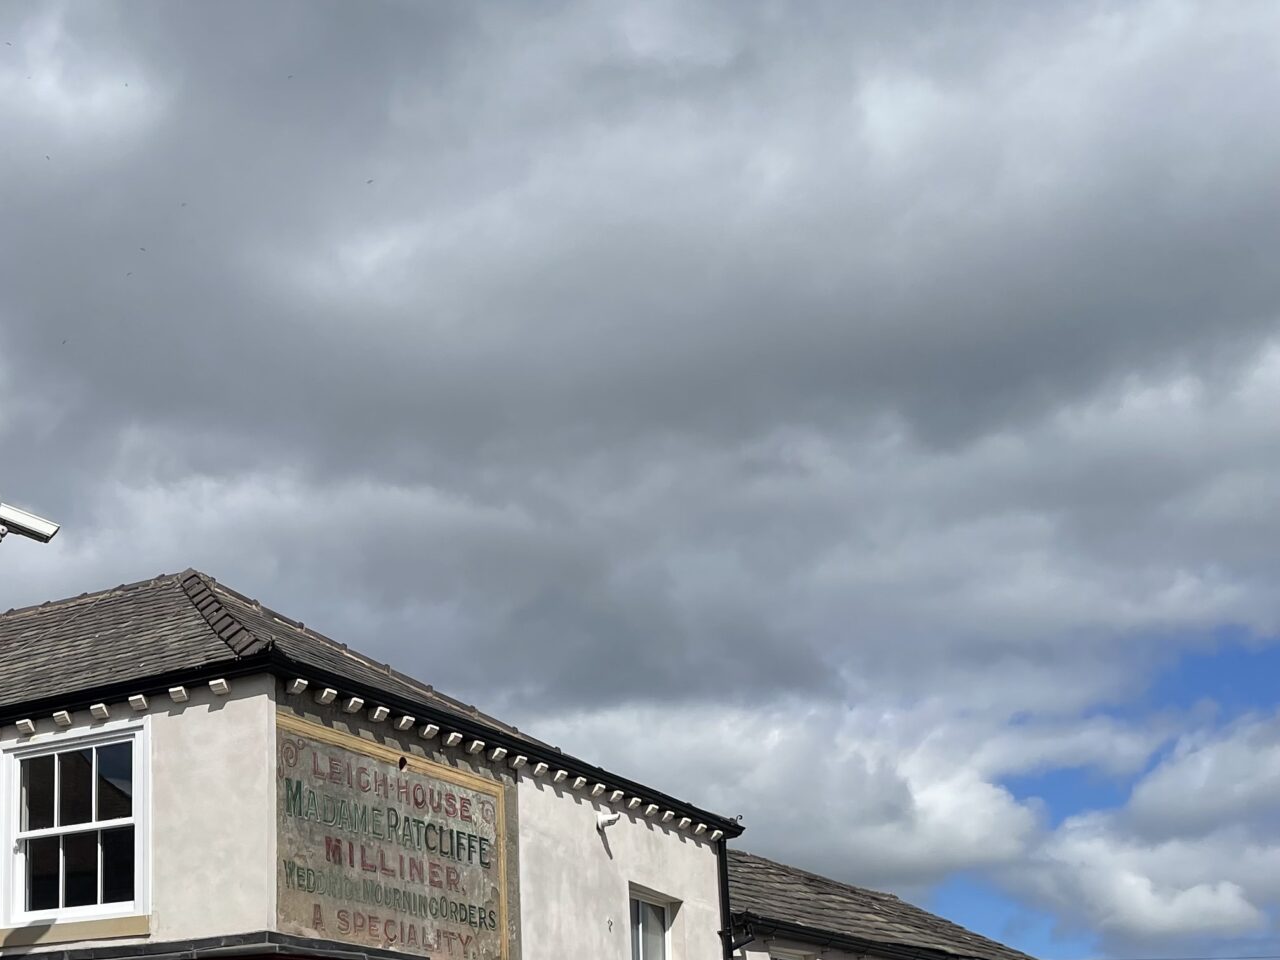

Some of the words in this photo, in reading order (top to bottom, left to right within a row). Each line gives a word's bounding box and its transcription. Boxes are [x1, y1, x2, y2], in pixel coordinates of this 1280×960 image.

[284, 777, 384, 840] MADAME
[387, 806, 492, 870] RATCLIFFE
[312, 902, 326, 932] A
[439, 895, 497, 931] ORDERS
